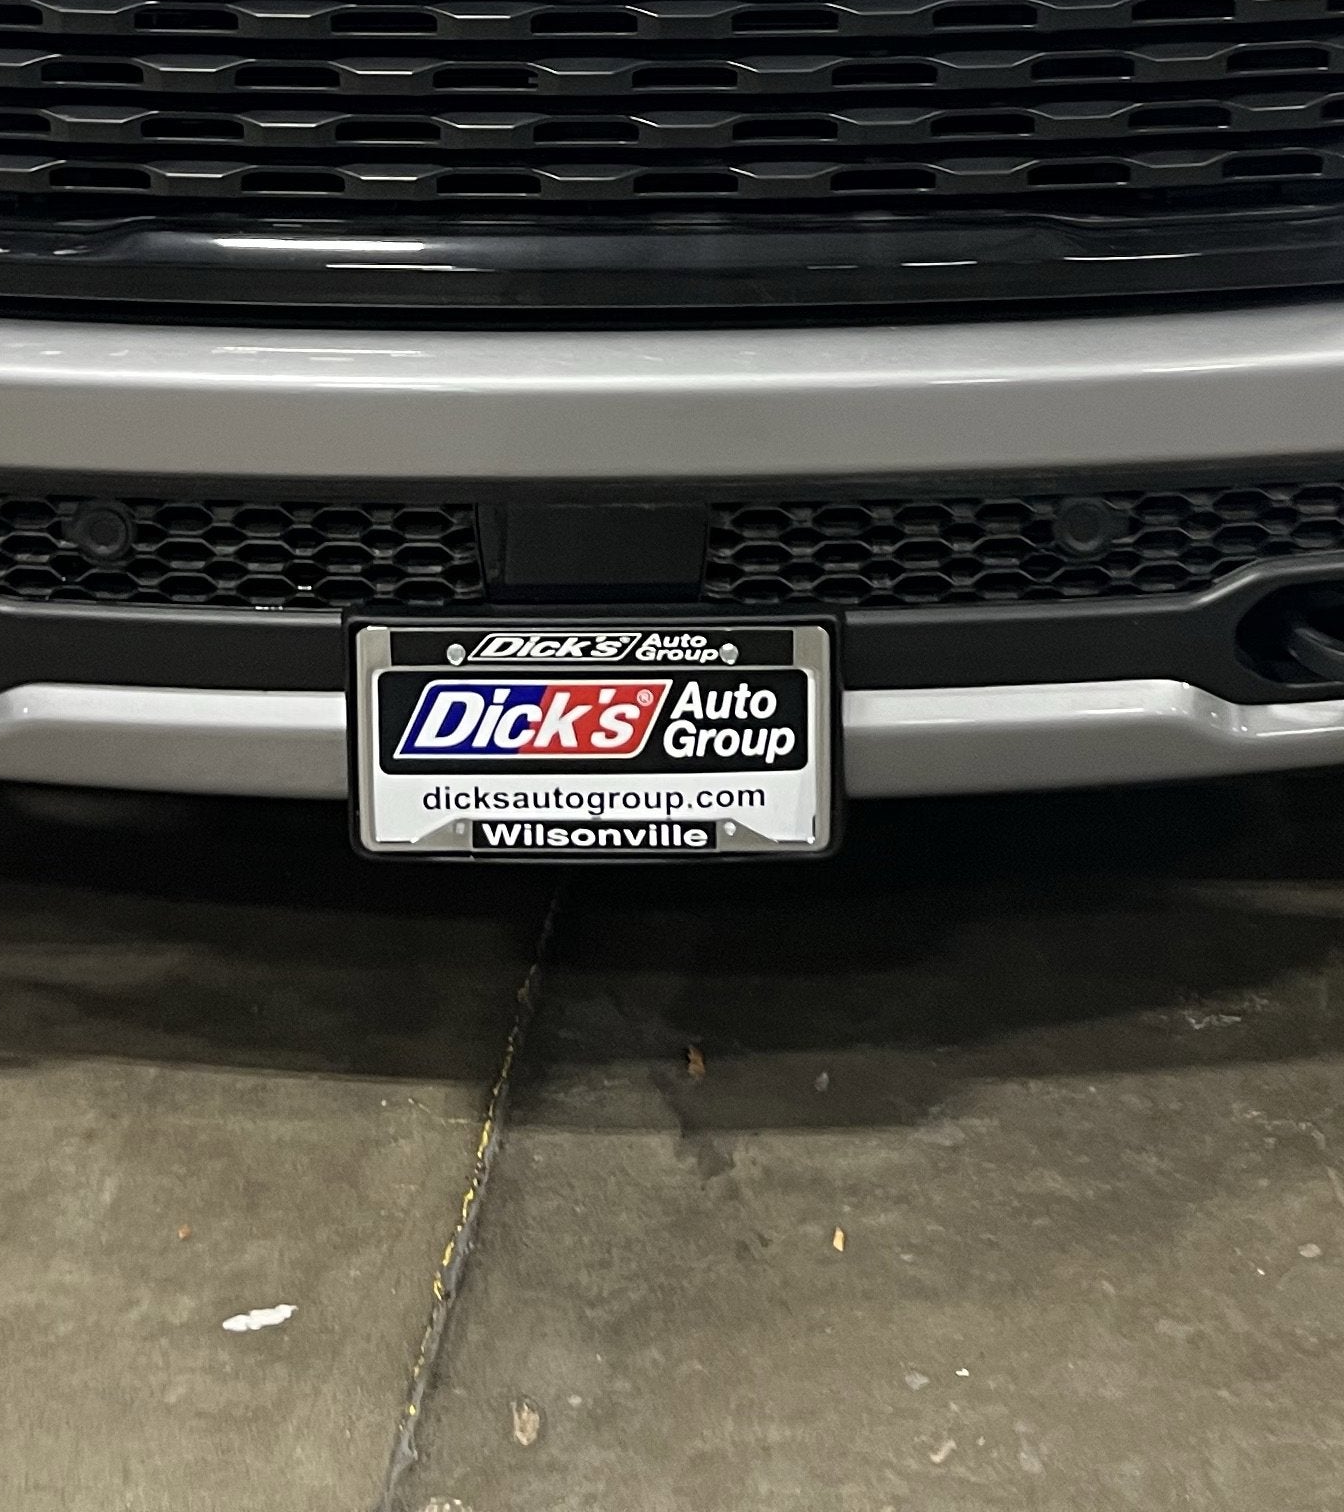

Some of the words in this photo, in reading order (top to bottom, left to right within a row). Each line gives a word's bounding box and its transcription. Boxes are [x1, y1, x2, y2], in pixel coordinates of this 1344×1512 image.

[479, 635, 624, 658] Dick's
[635, 646, 719, 663] Group
[641, 633, 708, 649] Auto
[669, 681, 778, 720] Auto
[413, 688, 640, 749] Dick's
[662, 720, 796, 763] Group
[422, 785, 766, 815] dicksautogroup.com
[481, 822, 709, 847] Wilsonville
